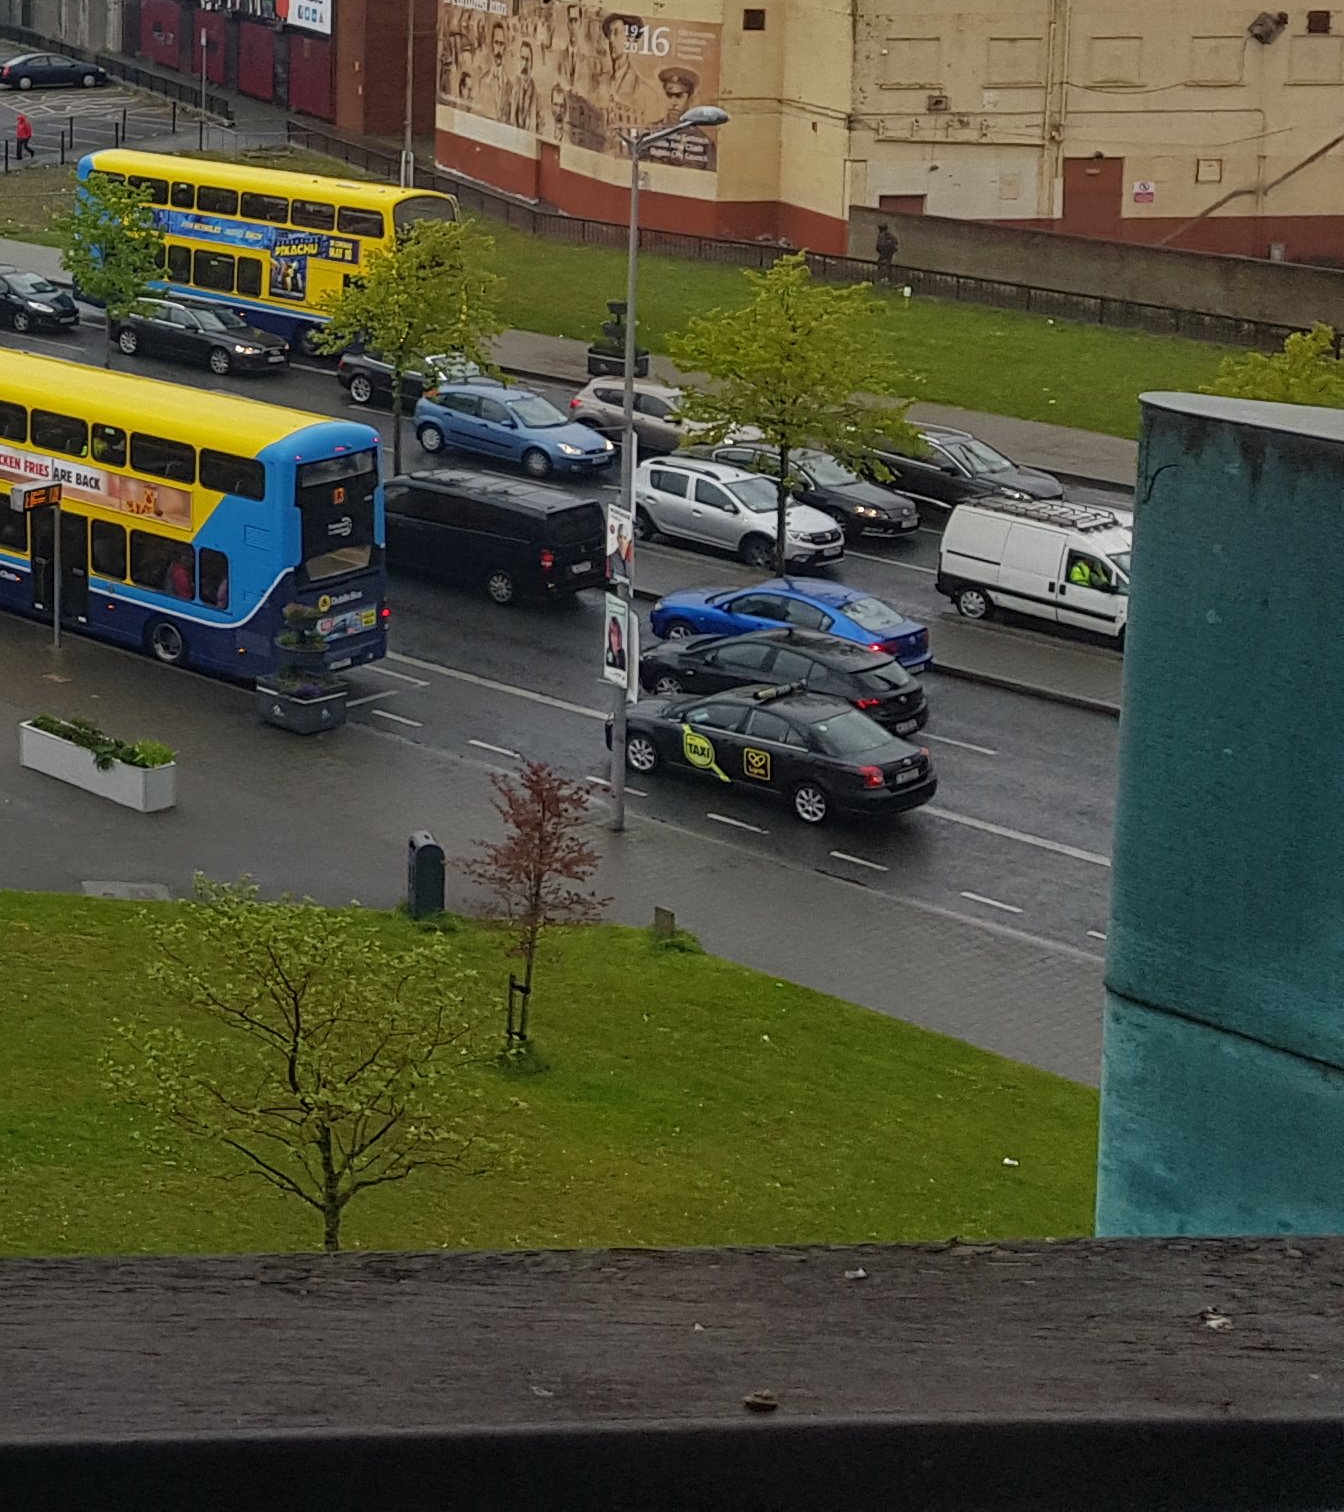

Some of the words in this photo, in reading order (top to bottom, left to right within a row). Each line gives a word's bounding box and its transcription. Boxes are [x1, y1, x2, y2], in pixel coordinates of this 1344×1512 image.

[624, 24, 639, 37] 19
[639, 24, 671, 58] 16
[275, 243, 319, 256] PIKACHU
[24, 459, 50, 478] FRIES
[53, 467, 73, 484] ARE
[75, 472, 101, 491] BACK
[687, 743, 710, 759] TAXI
